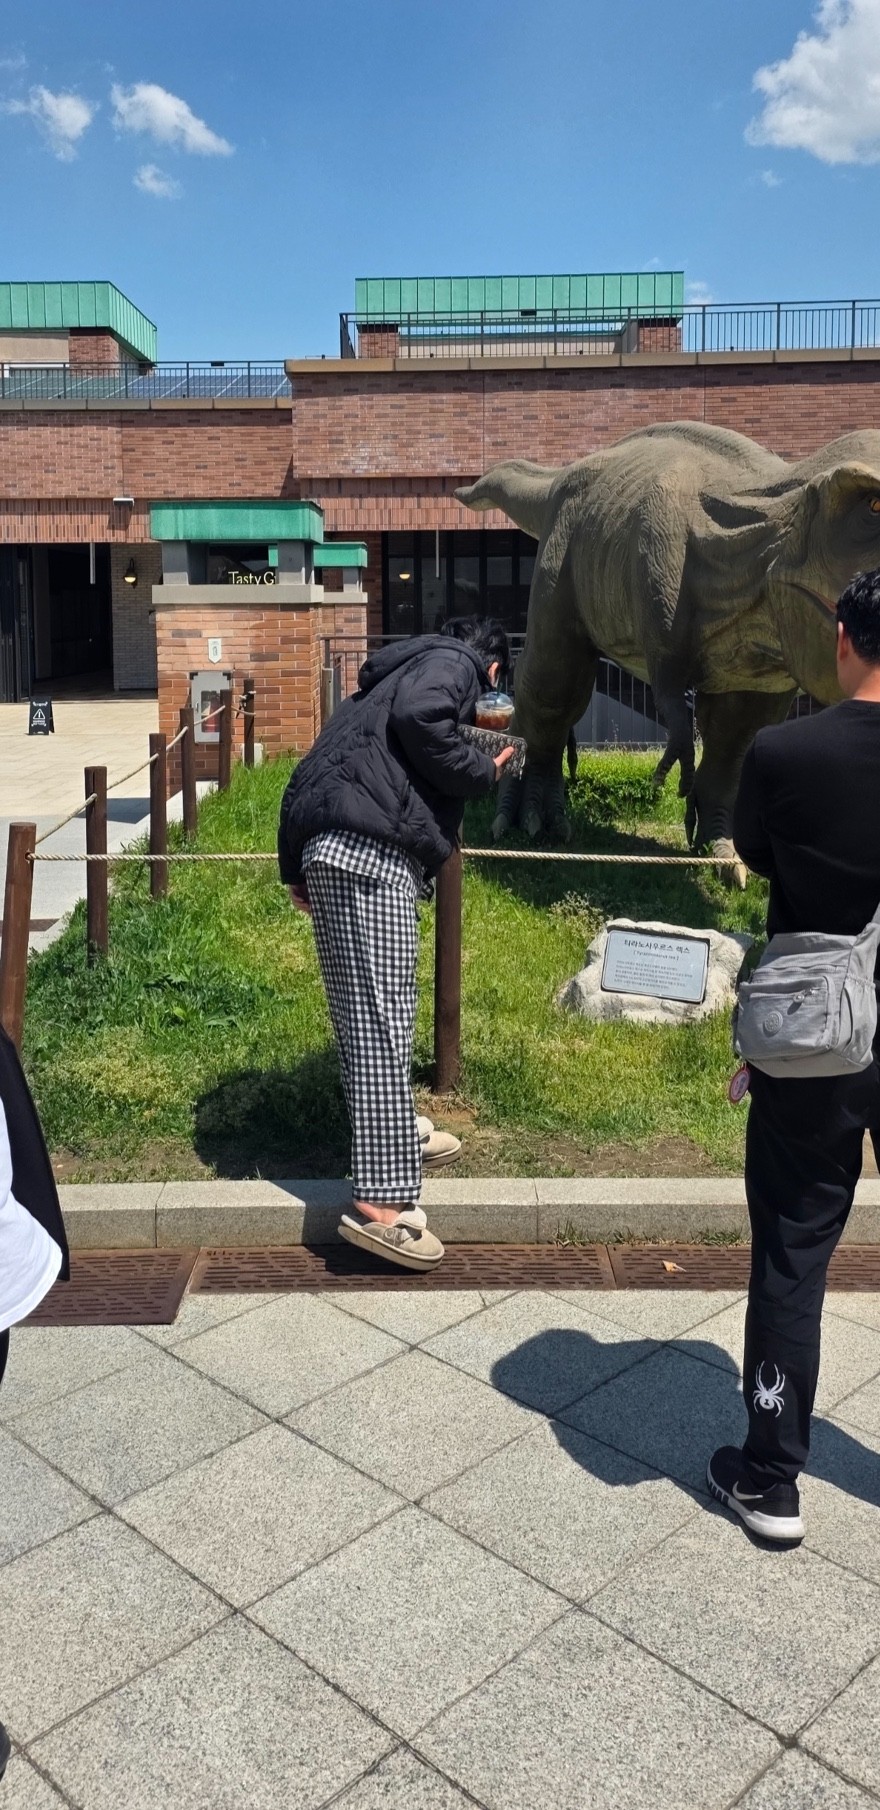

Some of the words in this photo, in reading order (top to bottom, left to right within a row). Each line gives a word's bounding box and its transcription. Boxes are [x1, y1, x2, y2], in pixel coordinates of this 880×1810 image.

[228, 571, 261, 585] Tasty
[263, 571, 276, 585] G
[676, 946, 690, 954] 렉스
